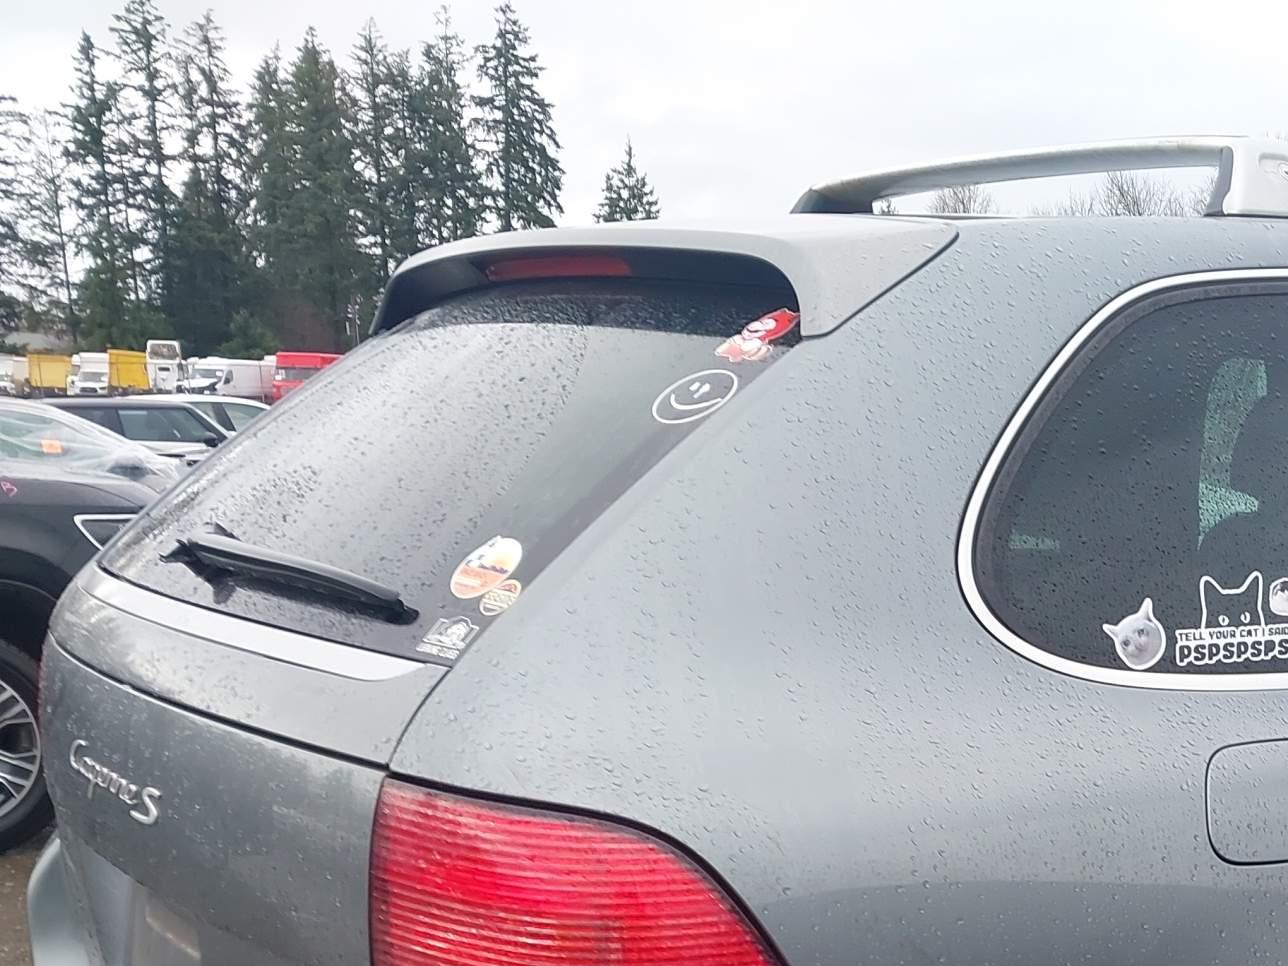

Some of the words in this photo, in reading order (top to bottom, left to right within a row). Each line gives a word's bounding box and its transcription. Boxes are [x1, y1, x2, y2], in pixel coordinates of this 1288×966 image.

[1178, 631, 1206, 642] TELL
[1209, 629, 1237, 640] YOUR
[1240, 628, 1260, 638] CAT
